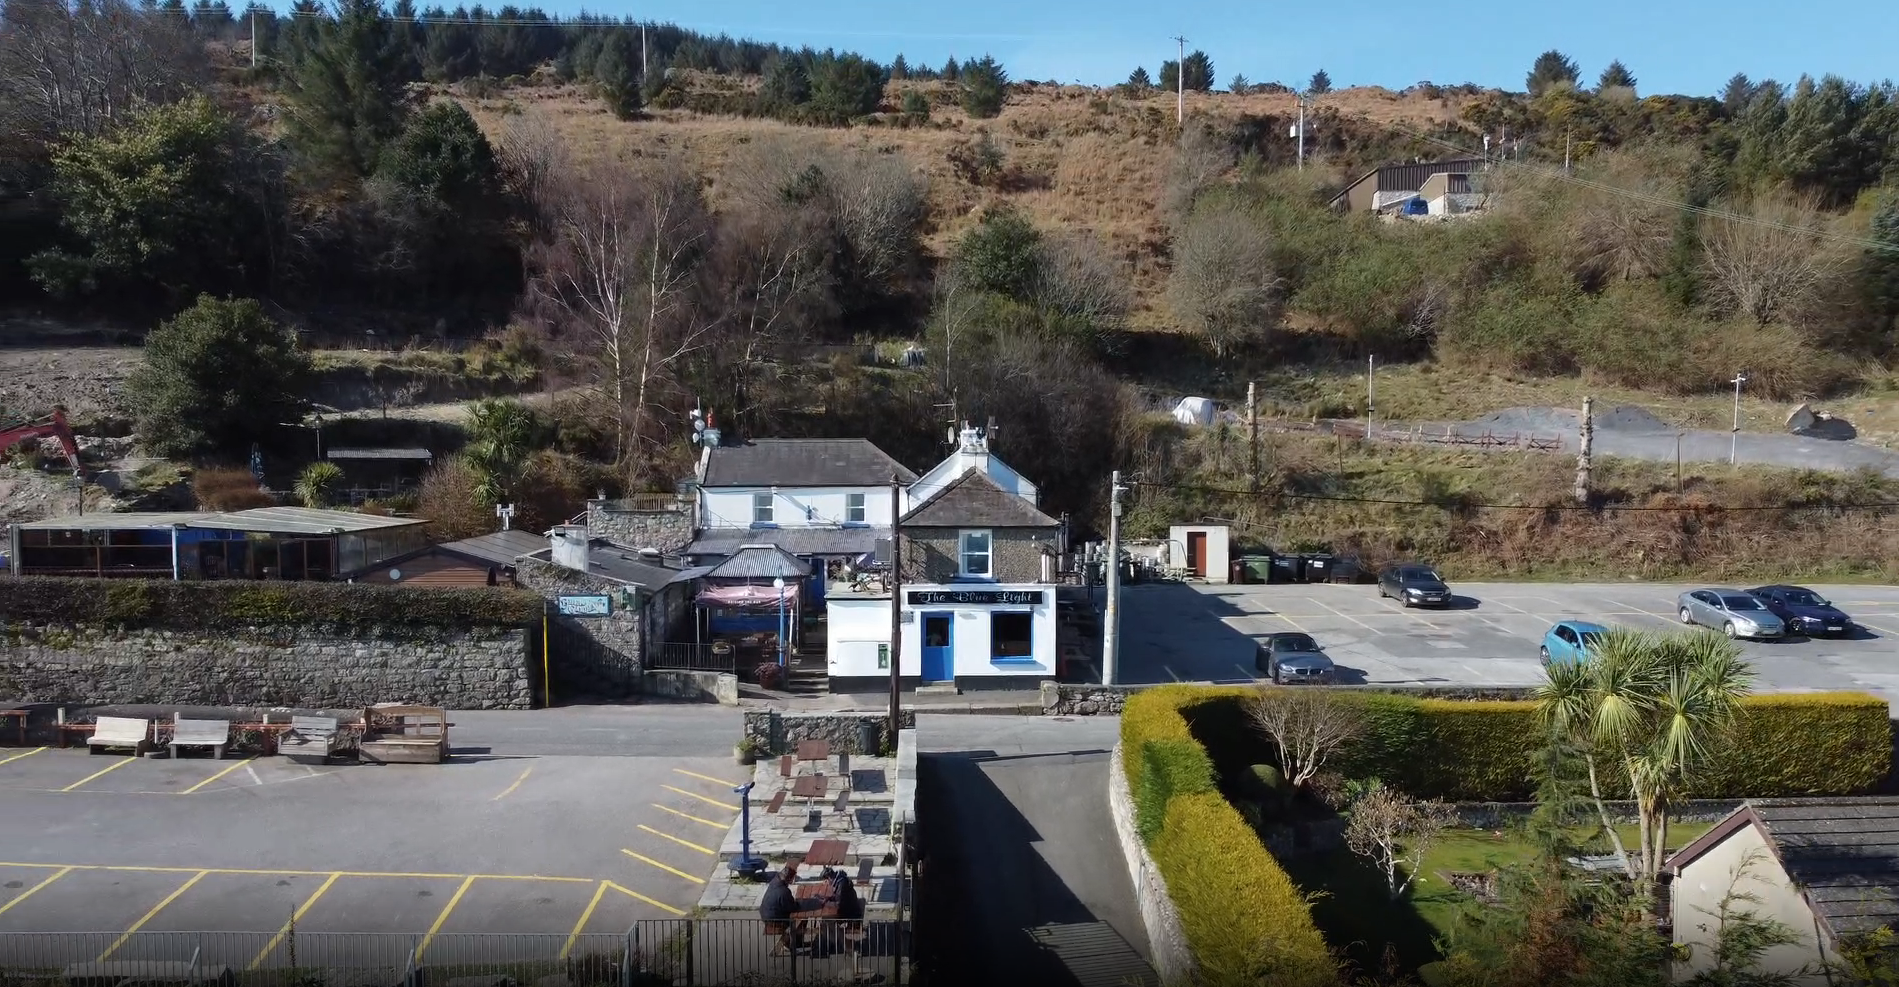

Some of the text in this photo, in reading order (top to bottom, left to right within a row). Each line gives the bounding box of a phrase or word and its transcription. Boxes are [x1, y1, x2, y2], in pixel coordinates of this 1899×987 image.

[917, 591, 1032, 603] The Blue Light
